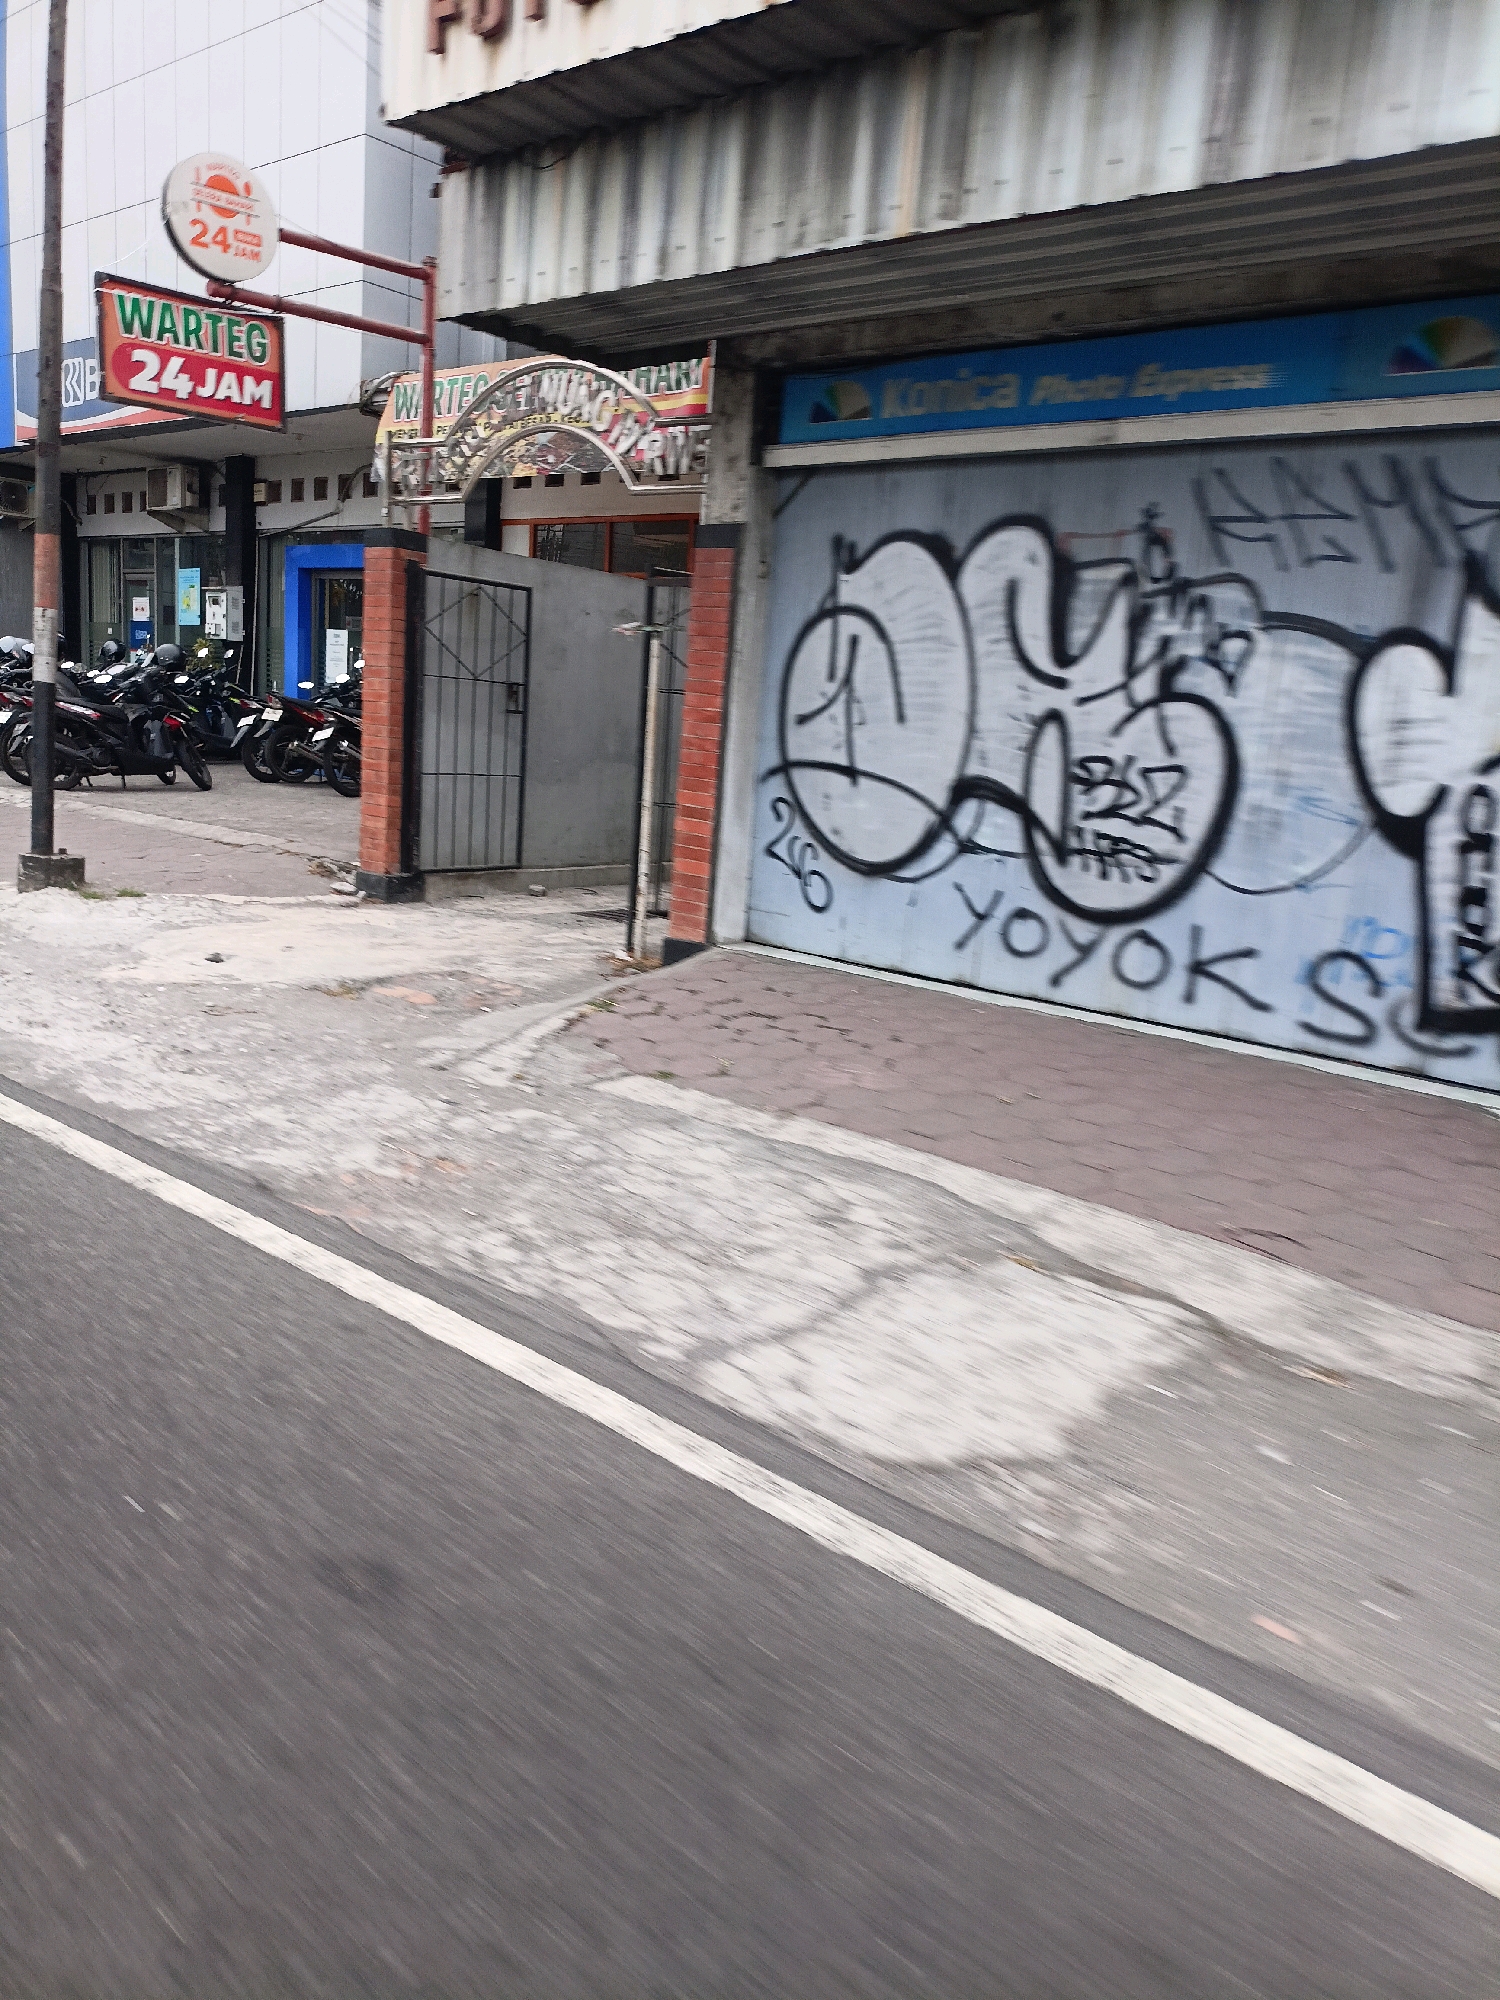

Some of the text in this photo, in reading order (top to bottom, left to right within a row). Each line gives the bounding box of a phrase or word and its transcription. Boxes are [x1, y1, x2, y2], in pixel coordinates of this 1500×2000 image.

[190, 218, 231, 253] 24
[114, 290, 269, 366] WARTEG
[129, 348, 194, 399] 24
[196, 368, 273, 409] JAM
[393, 371, 491, 423] WRTEG
[879, 367, 1020, 419] Konica
[952, 882, 1273, 1014] YOYOK
